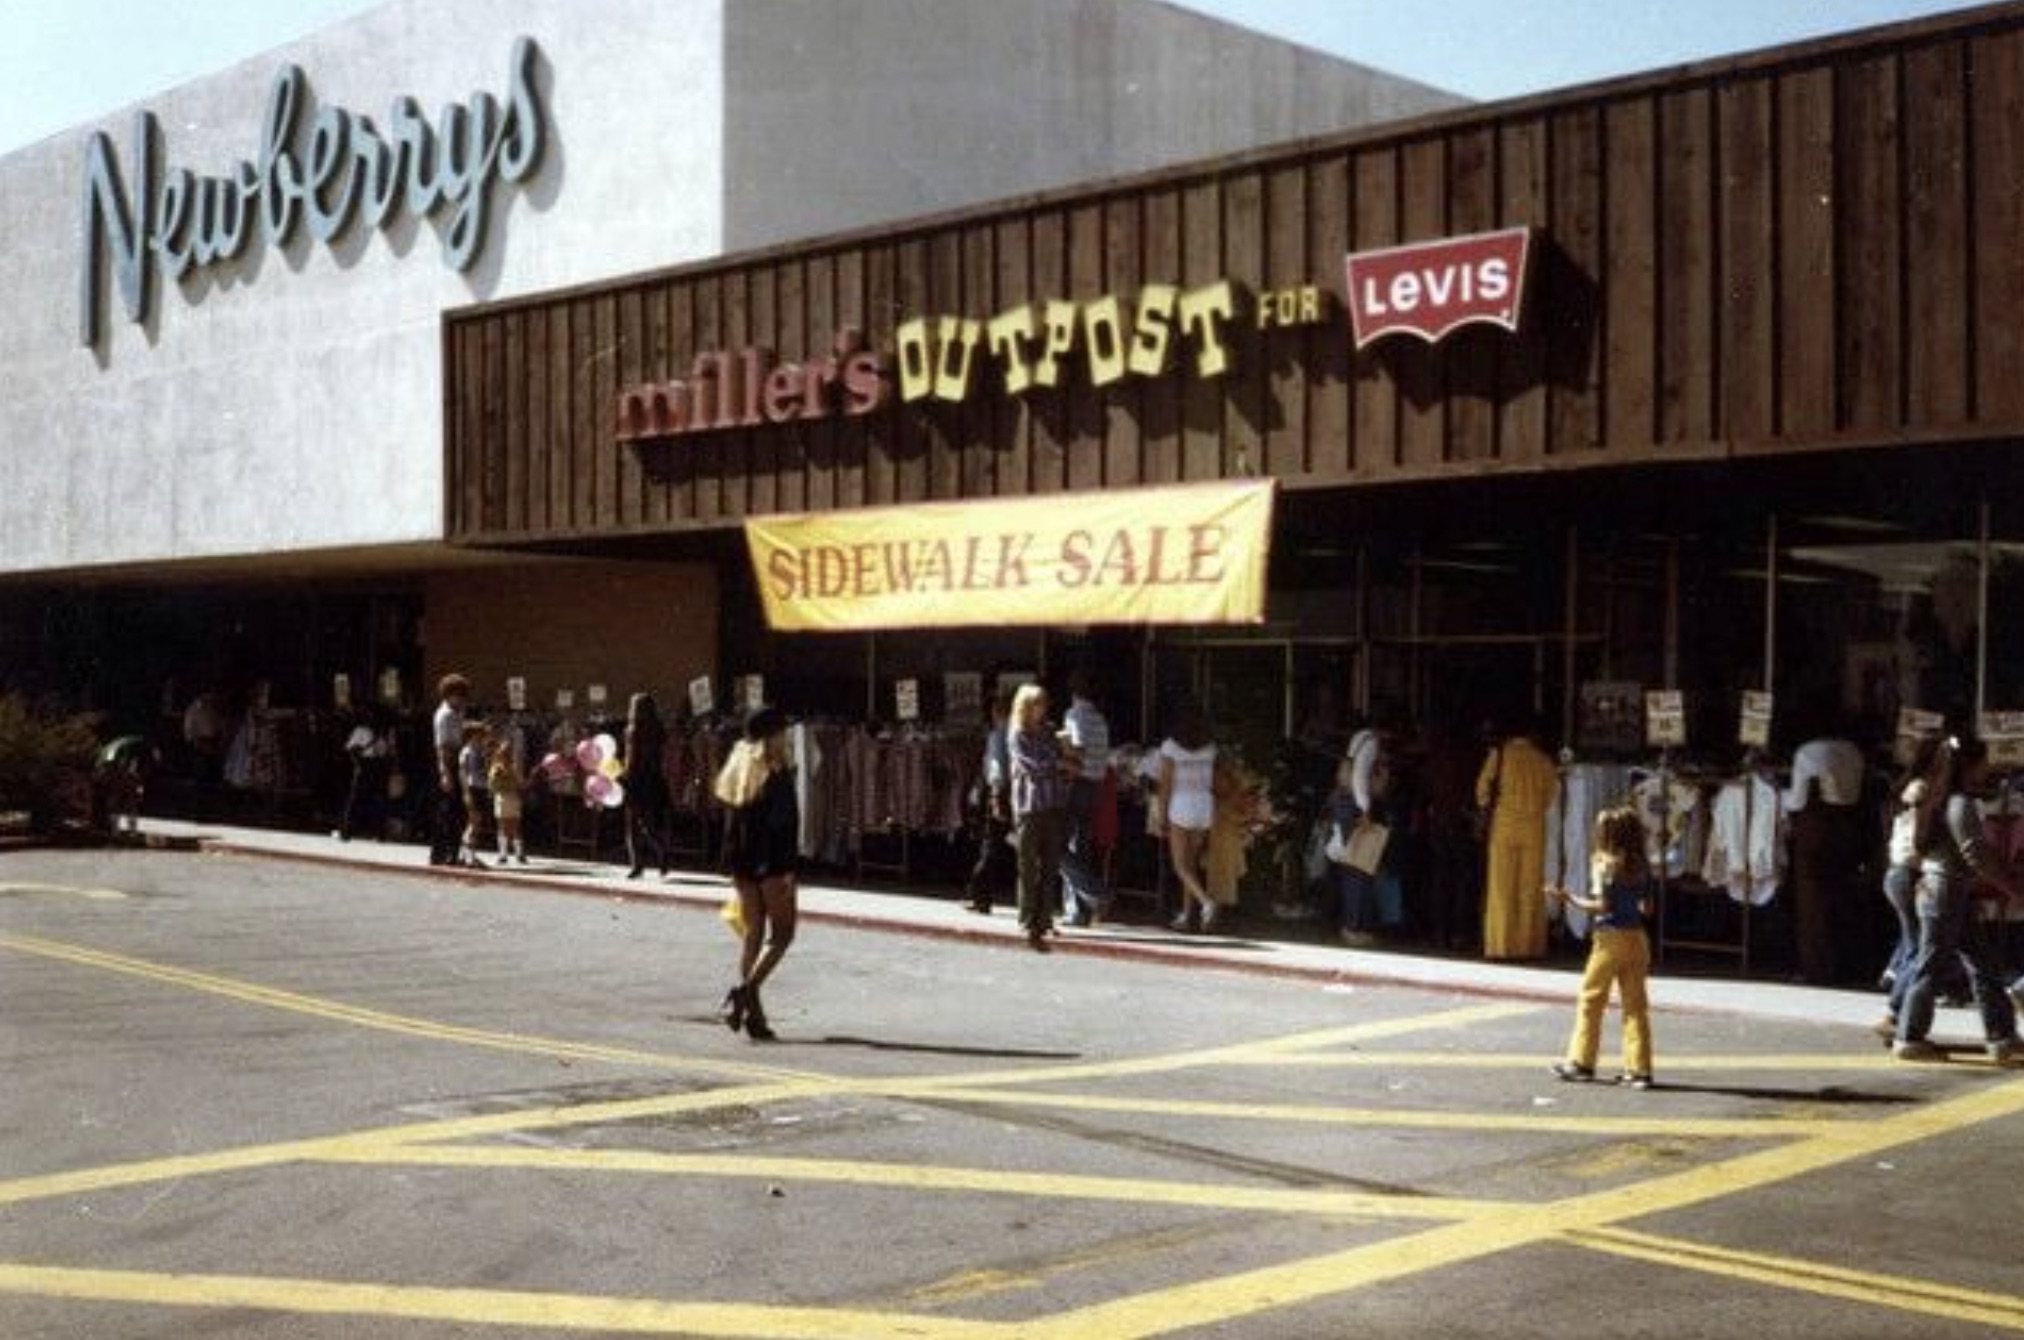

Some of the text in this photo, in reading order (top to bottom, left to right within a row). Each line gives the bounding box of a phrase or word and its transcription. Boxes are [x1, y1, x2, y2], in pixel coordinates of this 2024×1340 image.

[80, 36, 545, 349] Newberrys
[615, 281, 1320, 440] miller's OUTPOST FOR
[768, 523, 1231, 600] SIDEWALK SALE
